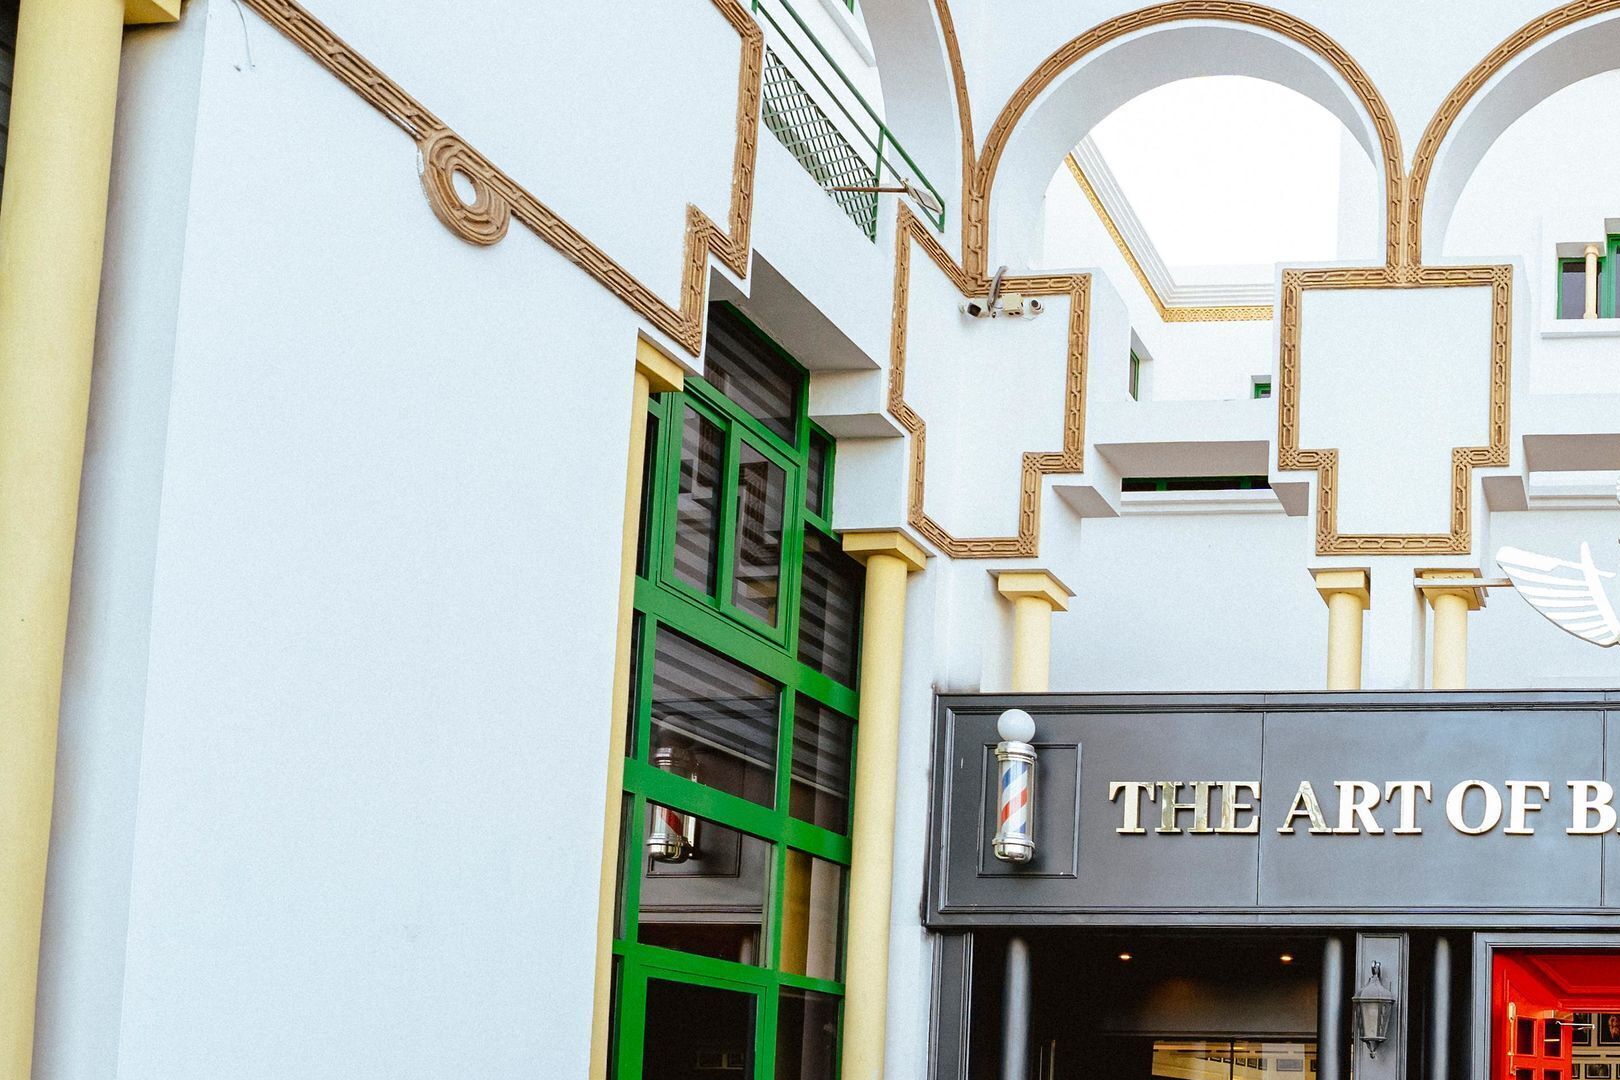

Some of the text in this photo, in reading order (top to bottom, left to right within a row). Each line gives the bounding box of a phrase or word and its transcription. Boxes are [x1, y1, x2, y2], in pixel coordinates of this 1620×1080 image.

[1108, 780, 1261, 834] THE
[1277, 780, 1432, 834] ART
[1445, 779, 1550, 835] OF
